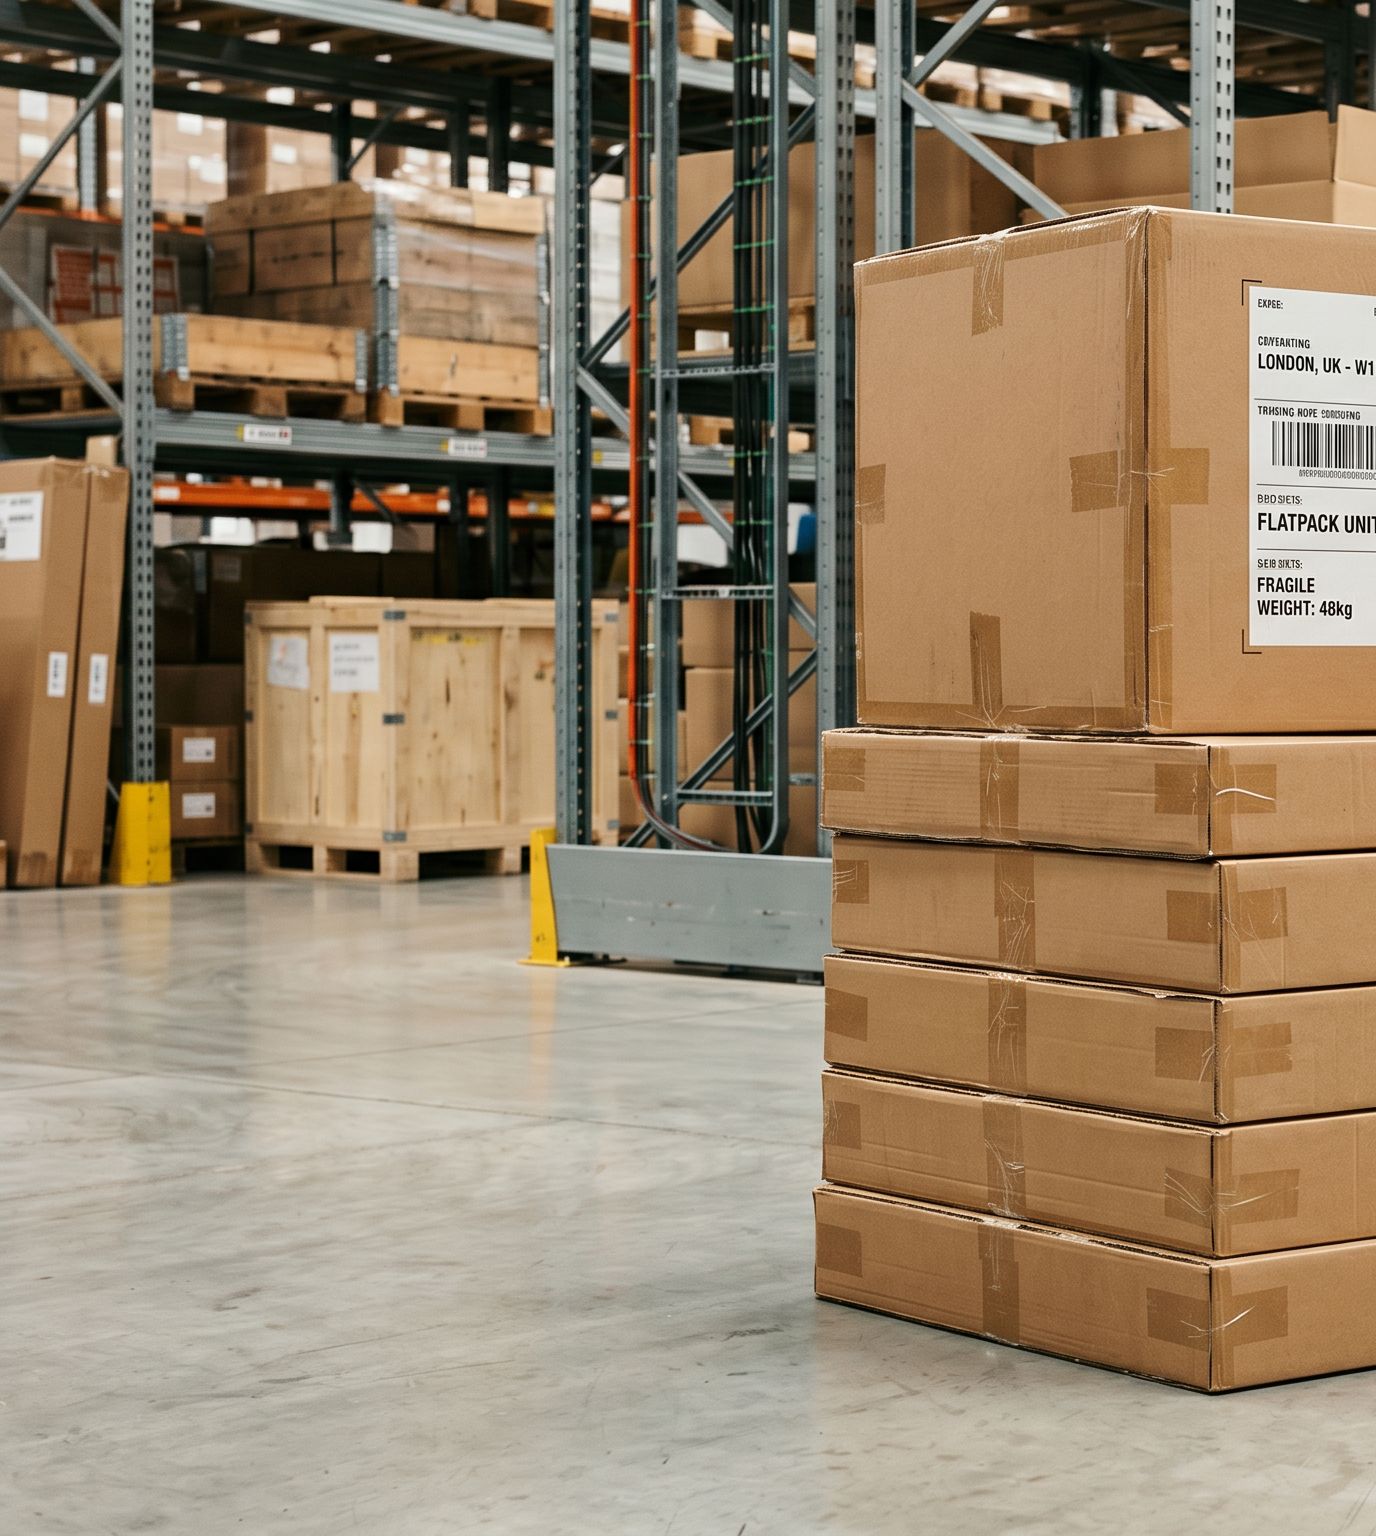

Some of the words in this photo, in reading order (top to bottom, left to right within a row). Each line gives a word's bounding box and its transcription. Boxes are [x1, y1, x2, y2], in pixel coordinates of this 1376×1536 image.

[1257, 352, 1318, 375] LONDON,
[1323, 357, 1342, 374] UK
[1257, 512, 1340, 533] FLATPACK
[1257, 576, 1315, 593] FRAGILE
[1256, 599, 1315, 616] WEIGHT:
[1319, 600, 1353, 620] 48kg
